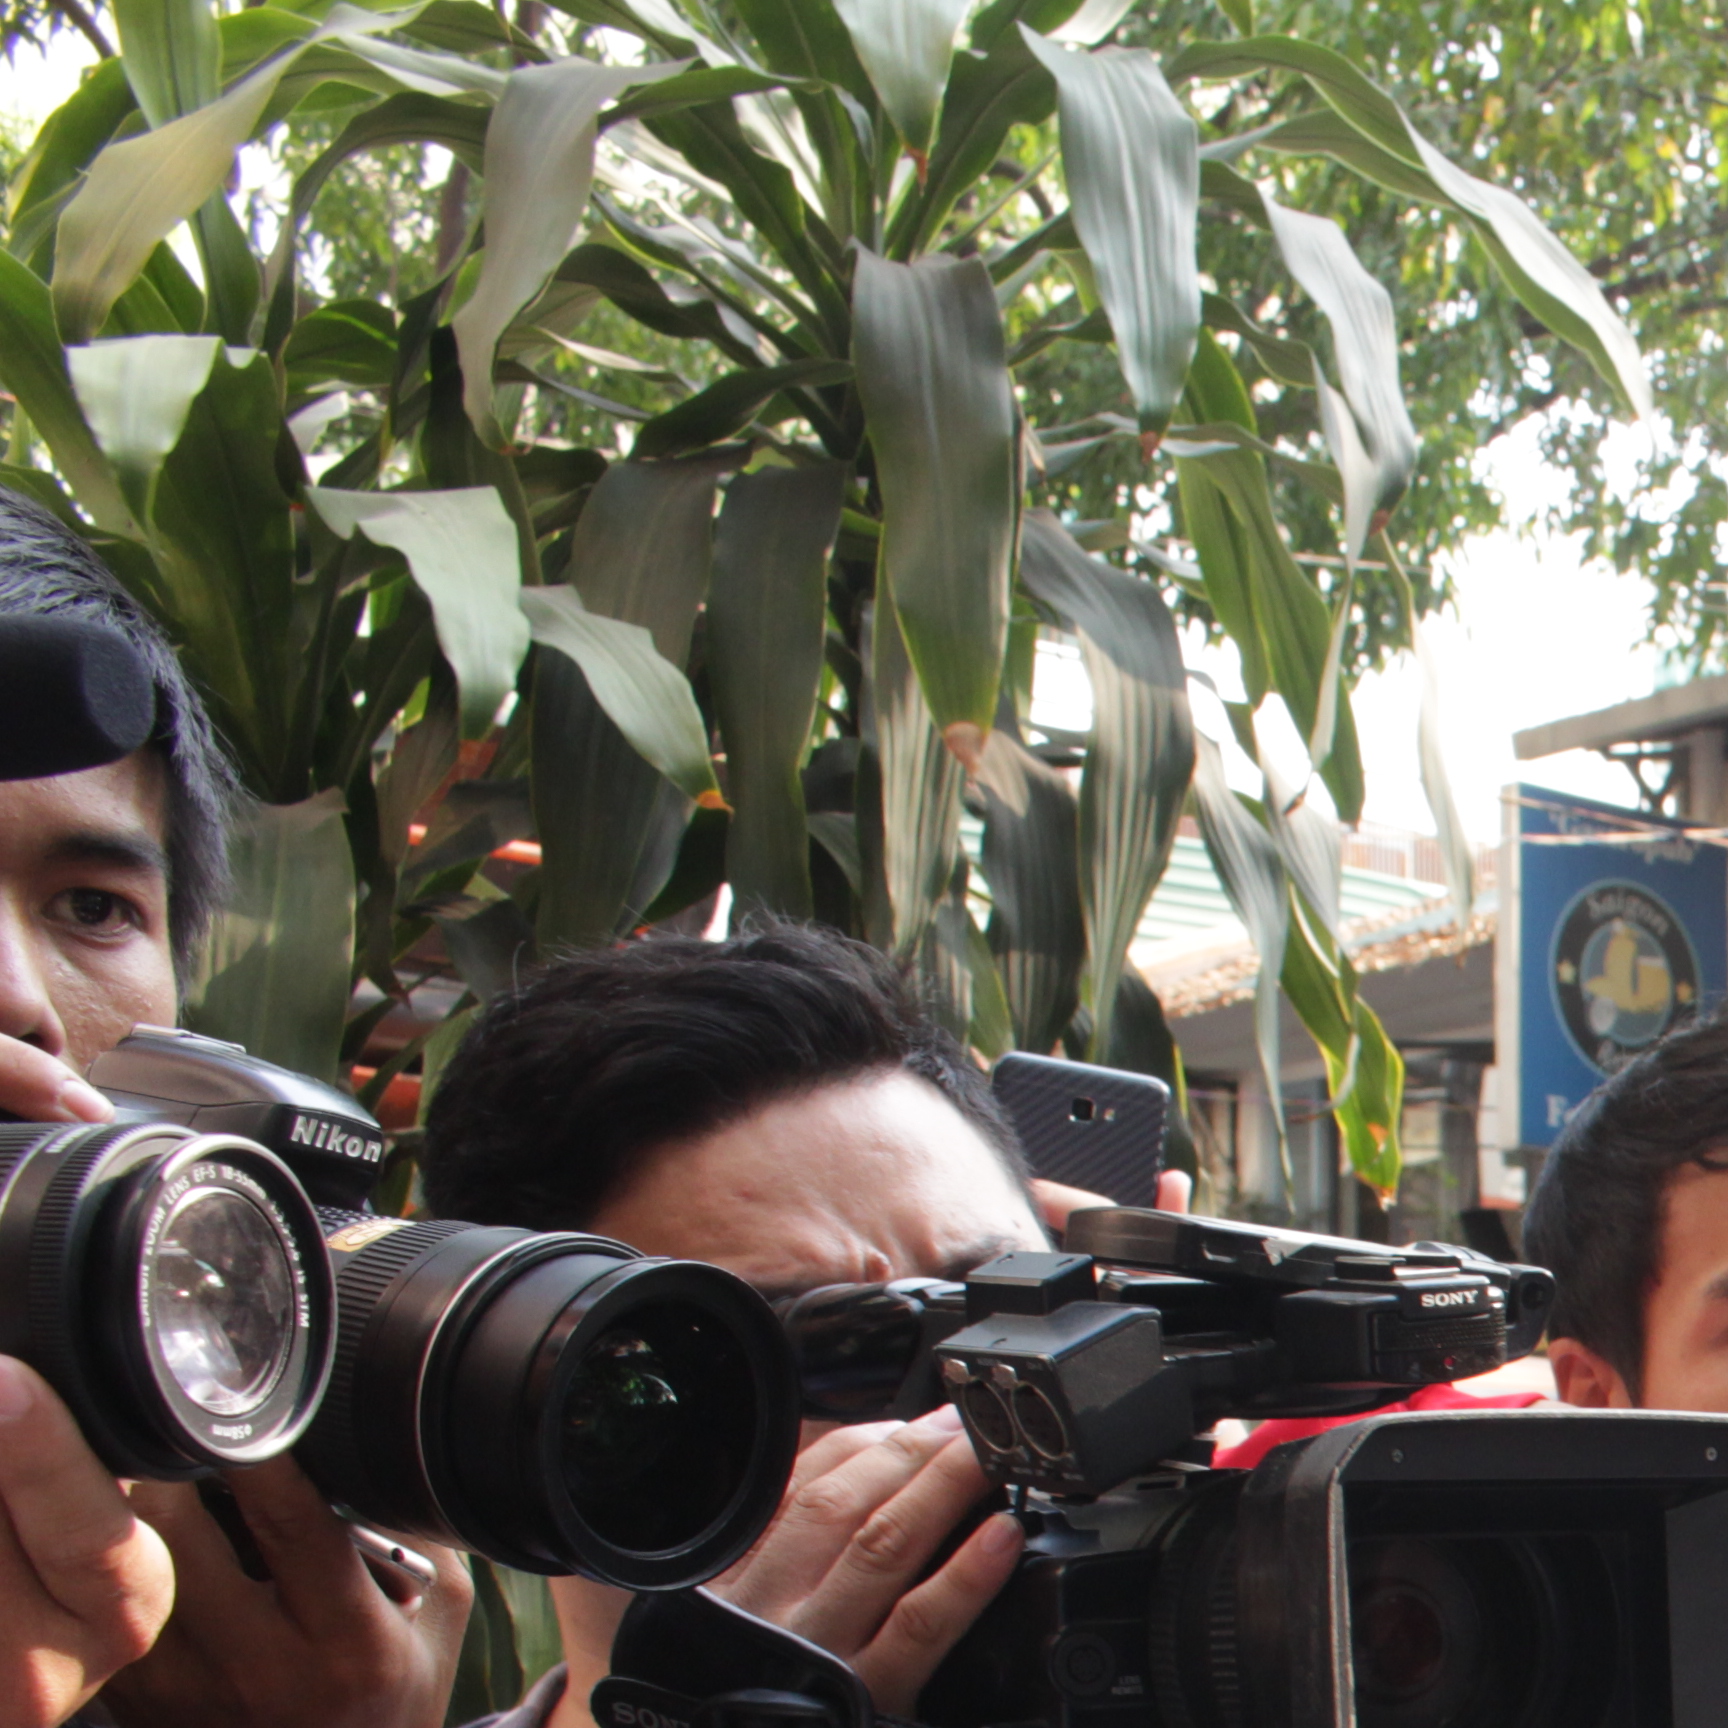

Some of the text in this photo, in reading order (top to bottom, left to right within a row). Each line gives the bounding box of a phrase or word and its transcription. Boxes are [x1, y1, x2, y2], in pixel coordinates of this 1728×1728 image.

[290, 1115, 382, 1163] Nikon
[166, 1176, 190, 1206] LENS
[193, 1165, 217, 1184] EF-S
[222, 1164, 267, 1201] 18-55mm
[1420, 1288, 1479, 1308] SONY
